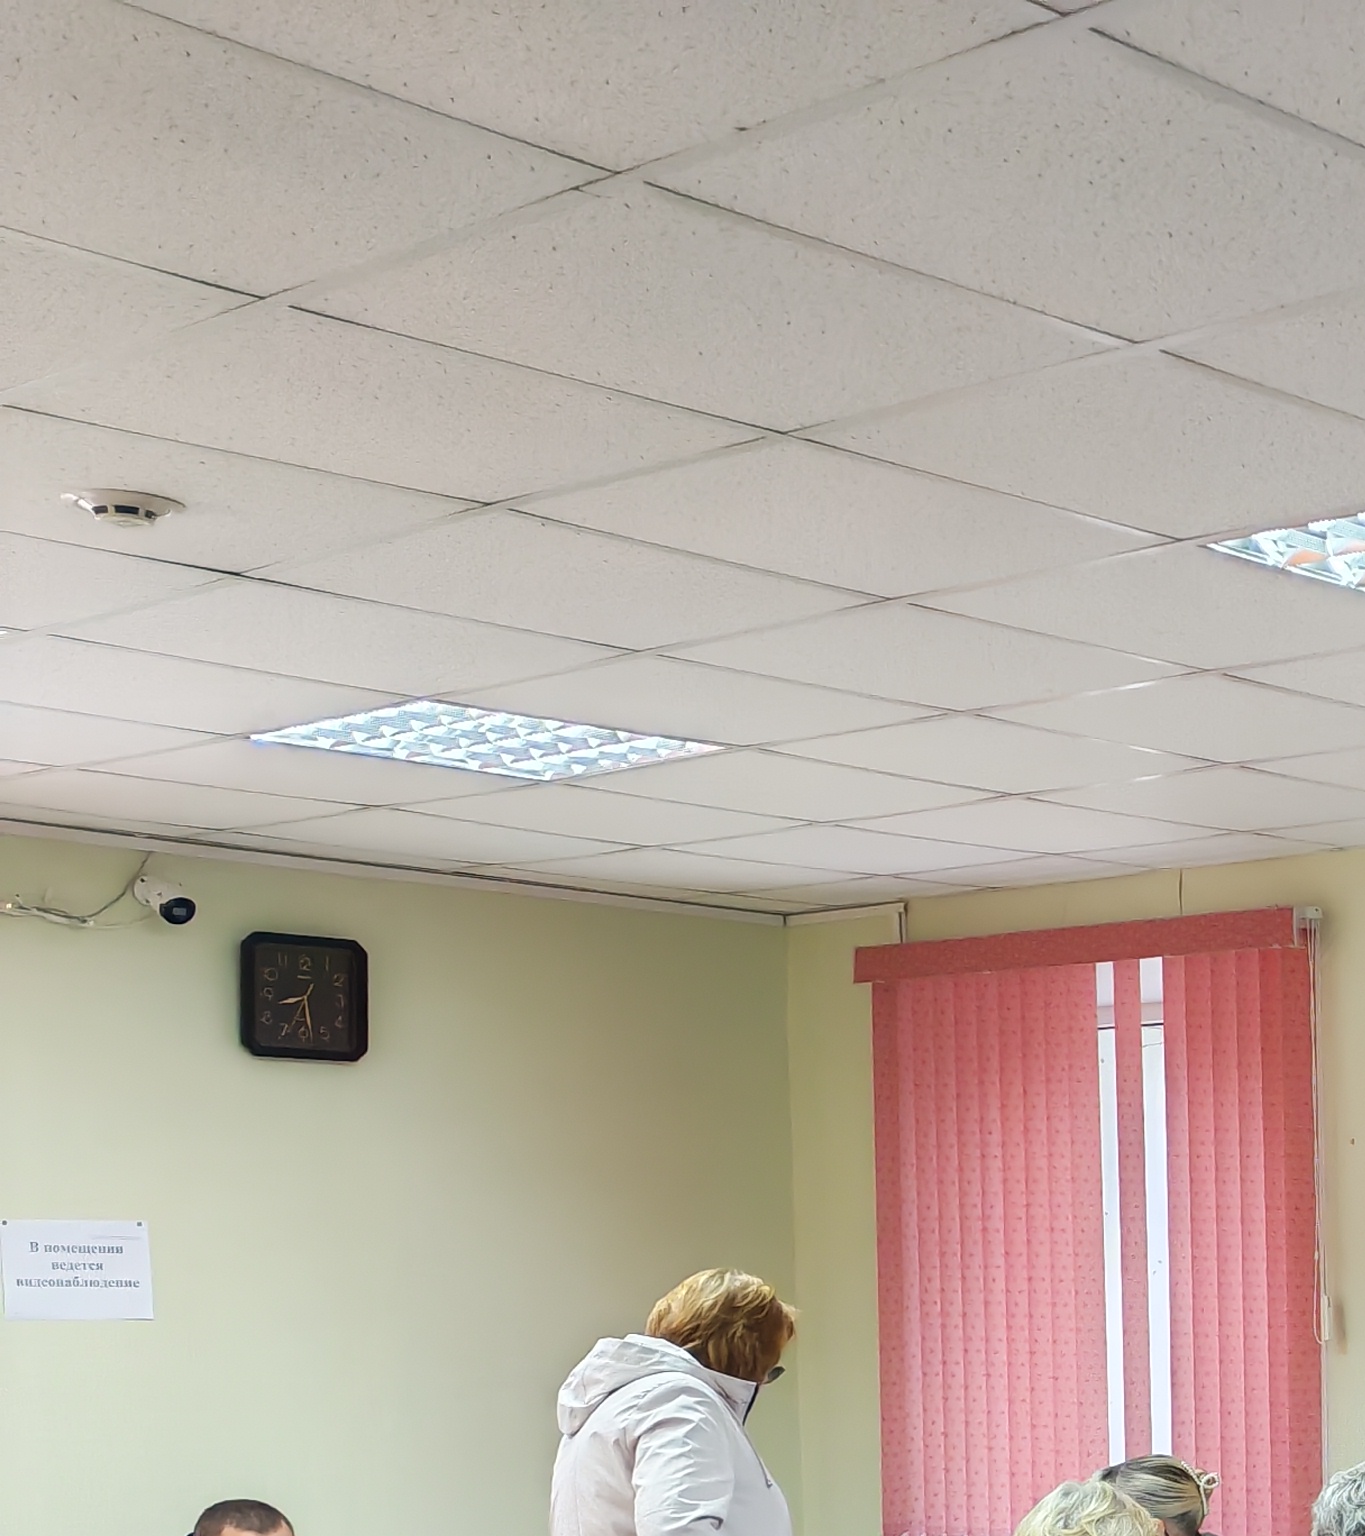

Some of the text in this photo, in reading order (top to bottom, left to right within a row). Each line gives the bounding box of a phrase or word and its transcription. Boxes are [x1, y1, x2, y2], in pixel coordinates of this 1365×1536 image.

[29, 1241, 124, 1255] В помещении
[51, 1261, 104, 1271] ведется
[16, 1276, 140, 1289] видеонаблюдение
